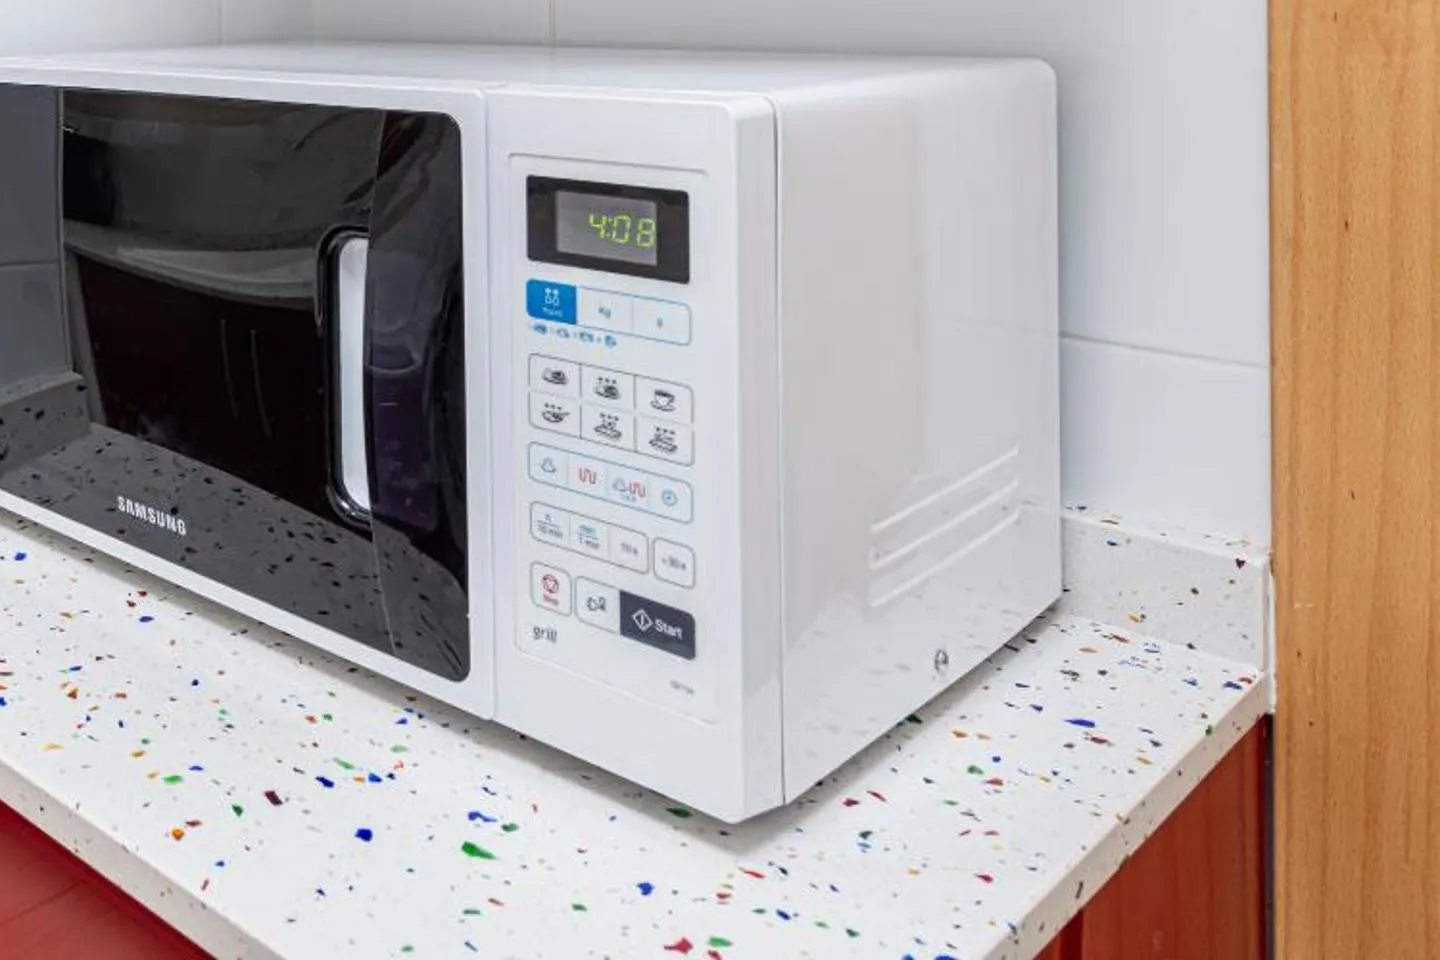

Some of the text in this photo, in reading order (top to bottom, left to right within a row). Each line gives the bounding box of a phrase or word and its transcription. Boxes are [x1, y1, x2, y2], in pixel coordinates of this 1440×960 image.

[588, 211, 657, 248] 4:08
[116, 495, 188, 537] SAMSUNG
[532, 625, 558, 644] grill
[654, 618, 683, 641] Start
